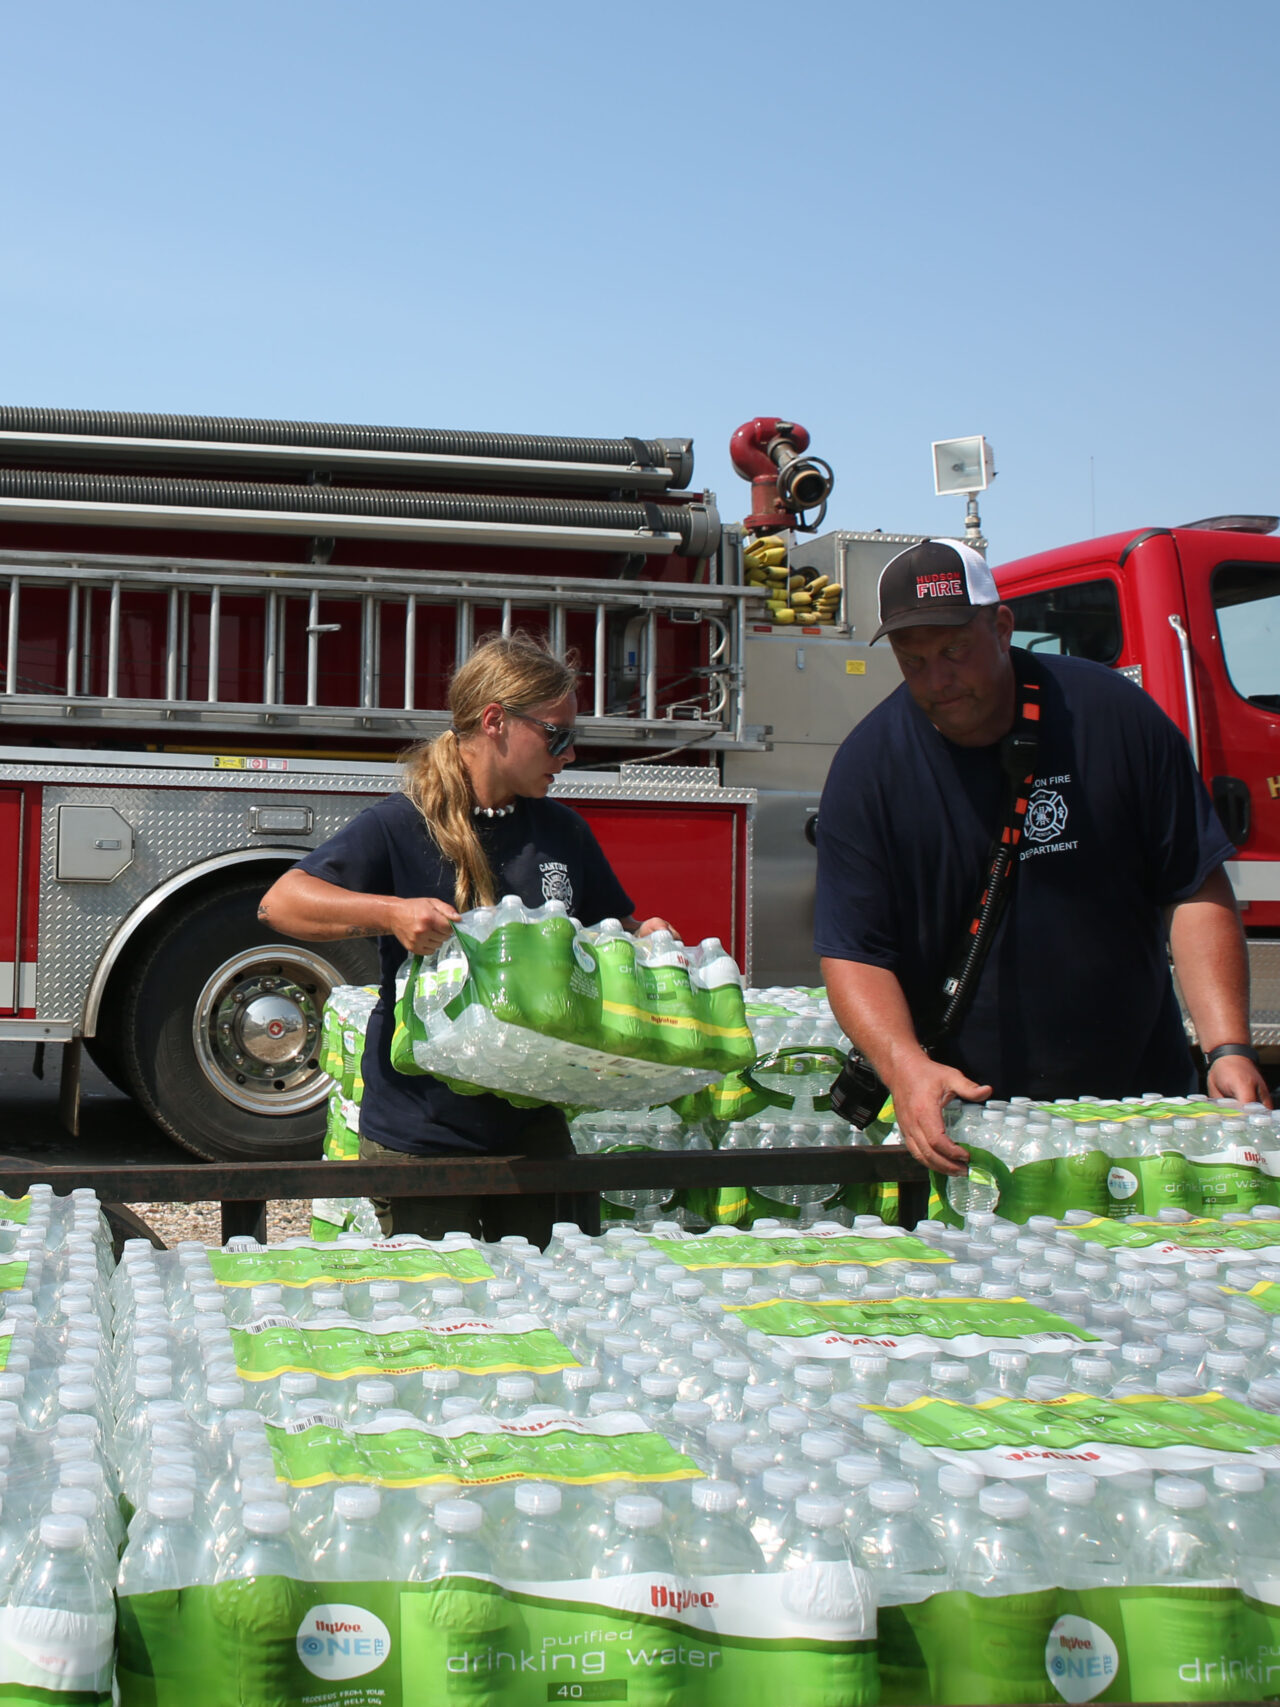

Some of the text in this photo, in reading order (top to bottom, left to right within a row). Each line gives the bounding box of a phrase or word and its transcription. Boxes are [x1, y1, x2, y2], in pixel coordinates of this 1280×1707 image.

[916, 572, 961, 583] HUDSON
[916, 580, 963, 598] FIRE
[1049, 775, 1071, 785] FIRE
[1020, 840, 1079, 861] DEPARTMENT
[539, 862, 568, 872] CANTON
[650, 1585, 717, 1612] HyVee
[315, 1620, 362, 1635] HyVee
[302, 1637, 372, 1656] ONE
[543, 1629, 633, 1650] purified
[447, 1644, 721, 1674] drinking water
[1051, 1655, 1103, 1679] ONE
[1178, 1655, 1280, 1684] drinkin
[556, 1684, 583, 1698] 40
